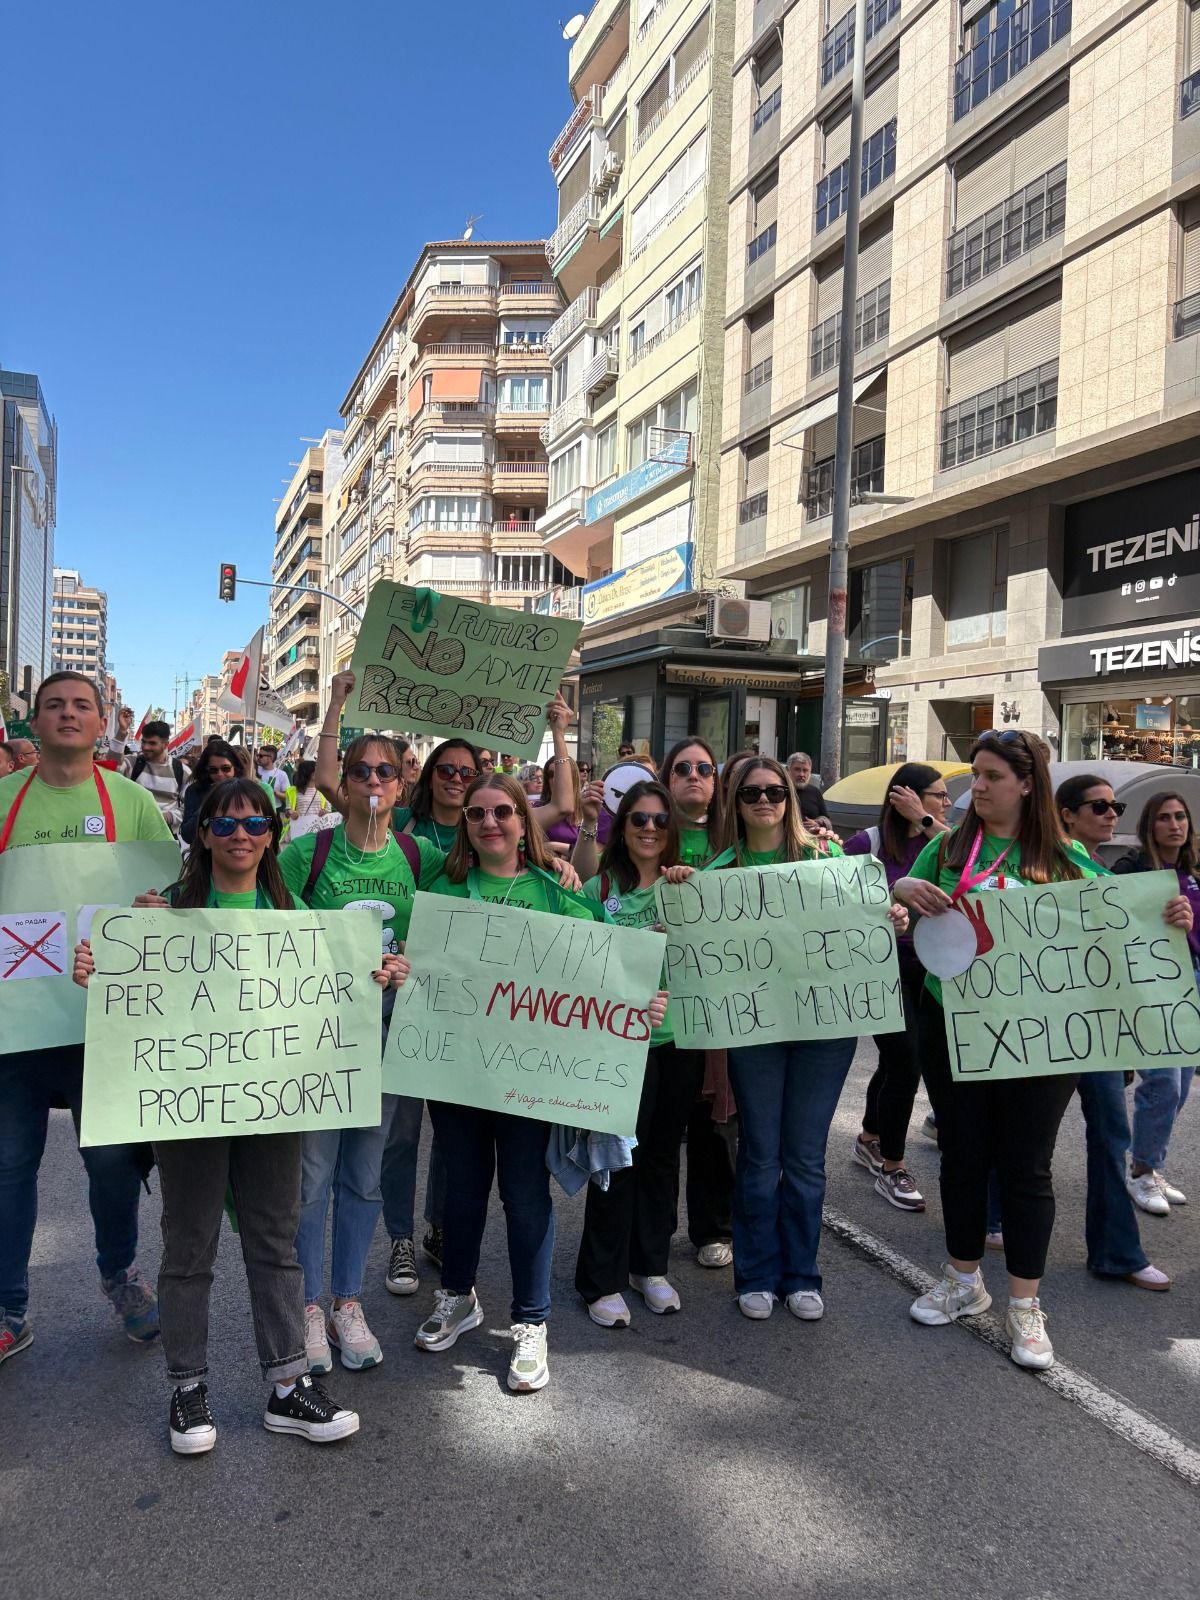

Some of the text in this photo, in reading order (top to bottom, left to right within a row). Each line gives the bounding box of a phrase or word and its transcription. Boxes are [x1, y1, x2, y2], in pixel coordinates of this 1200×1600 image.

[448, 603, 559, 652] FUTURO
[381, 624, 564, 697] NO ADMITE
[673, 669, 717, 685] kiosko
[358, 665, 542, 745] RECORTES
[60, 825, 78, 838] del
[330, 878, 409, 900] ESTIMEN
[659, 863, 889, 927] EDUQUEM AMB
[999, 881, 1130, 944] NO ÉS
[98, 914, 326, 976] SEGURETAT
[664, 923, 894, 982] PASSIÓ, PERÒ
[1124, 935, 1182, 984] ÉS
[105, 971, 354, 1016] PER A EDUCAR
[405, 972, 650, 1042] MÉS MANCANCES
[672, 977, 904, 1038] TAMBÉ MENGEM
[133, 1015, 358, 1072] RESPECTE AL
[397, 1024, 629, 1088] QUE VACANCES
[951, 987, 1200, 1073] EXPLOTACIÓ
[138, 1068, 362, 1128] PROFESSORAT
